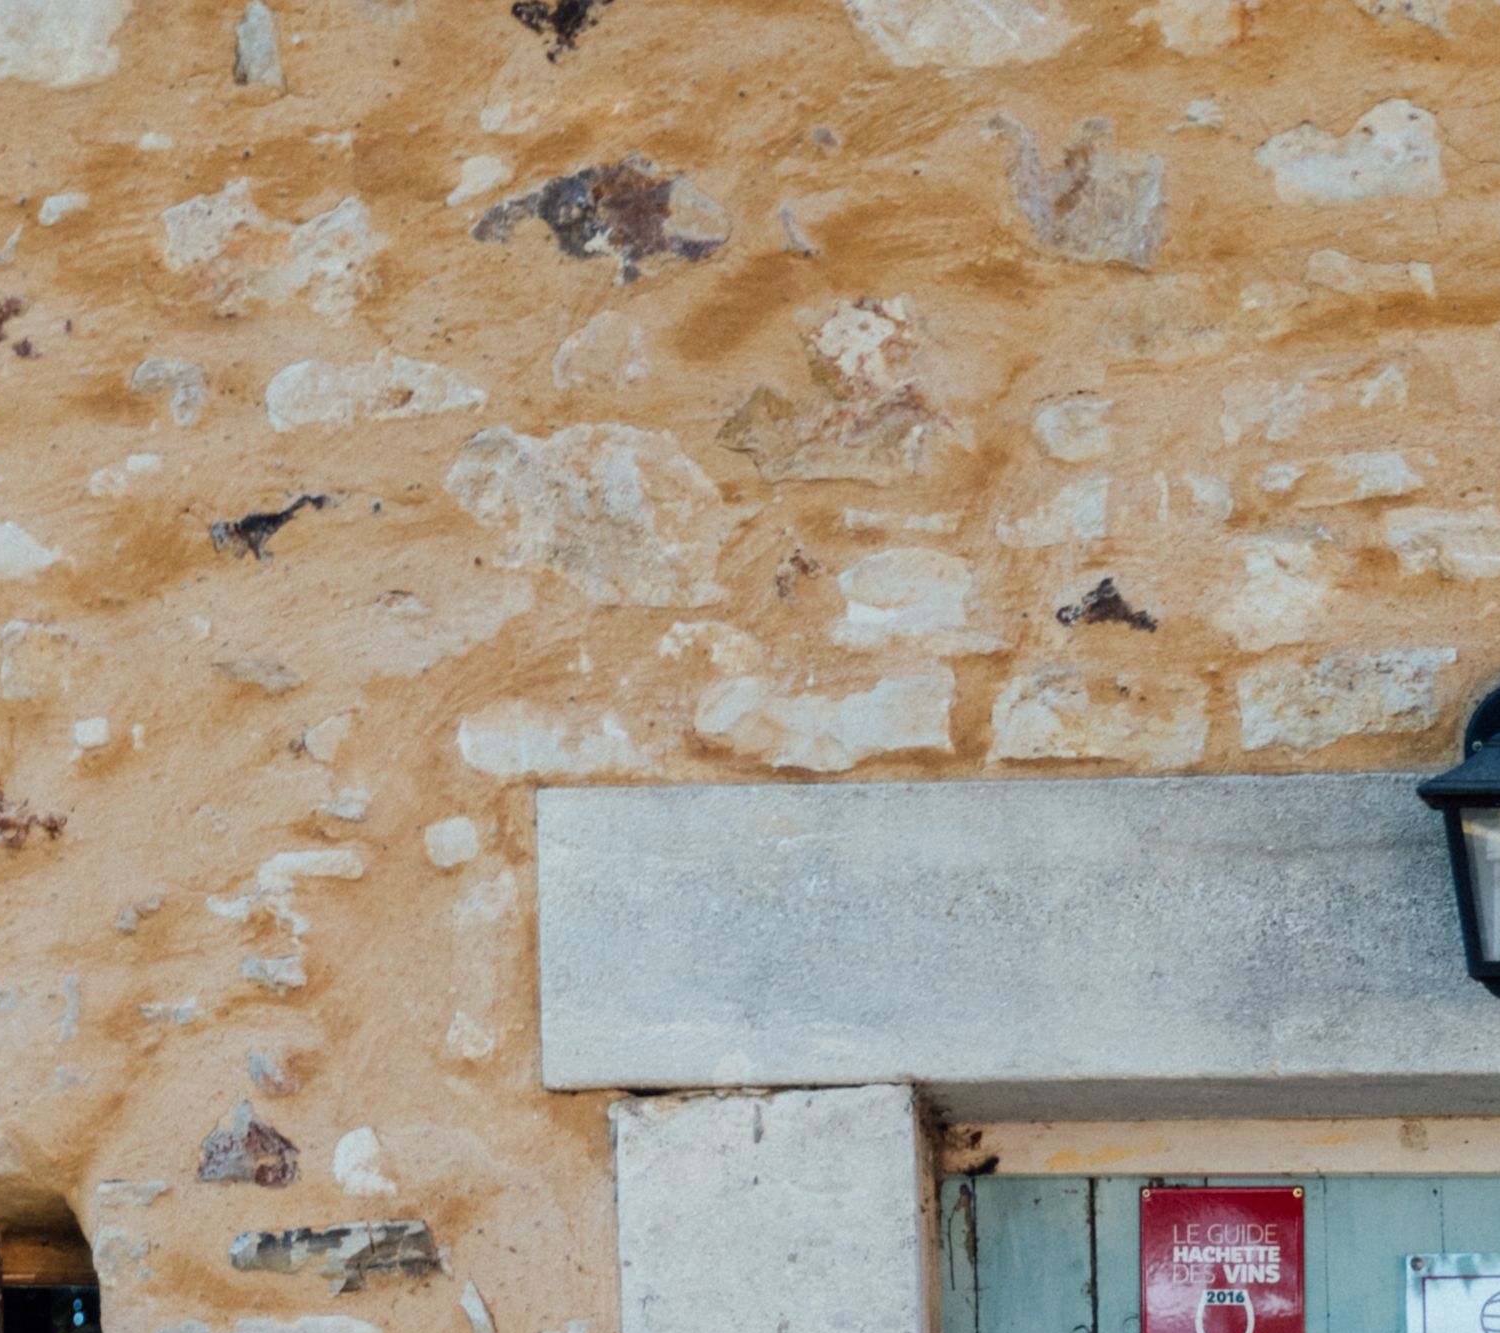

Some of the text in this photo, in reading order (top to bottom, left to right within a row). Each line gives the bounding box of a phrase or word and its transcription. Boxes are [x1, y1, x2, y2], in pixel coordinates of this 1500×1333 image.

[1173, 1224, 1278, 1244] LE GUIDE
[1173, 1247, 1280, 1263] HACHETTE
[1172, 1264, 1280, 1283] DES VINS
[1207, 1291, 1244, 1303] 2016
